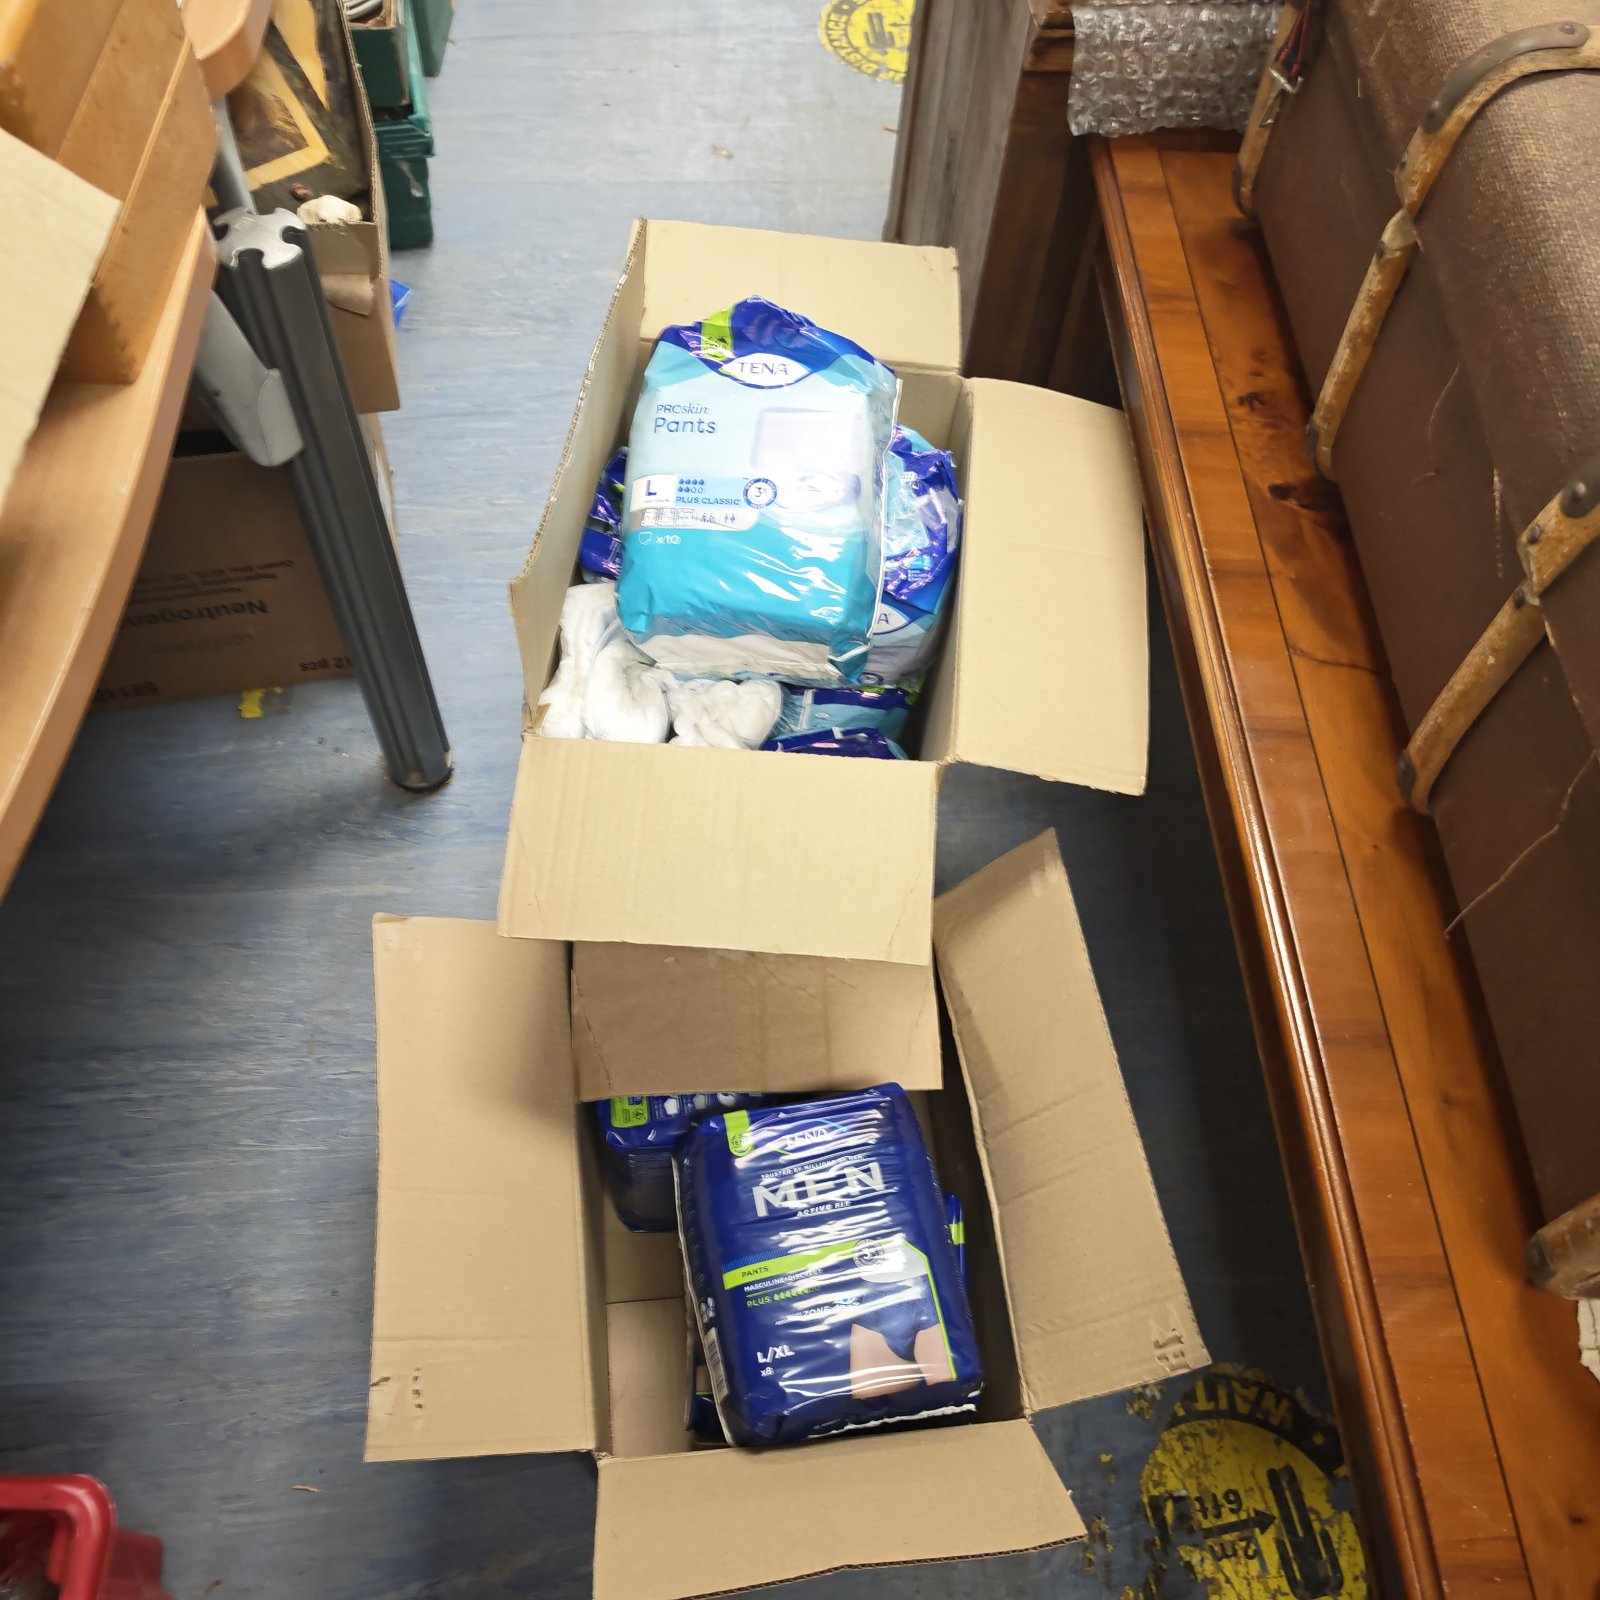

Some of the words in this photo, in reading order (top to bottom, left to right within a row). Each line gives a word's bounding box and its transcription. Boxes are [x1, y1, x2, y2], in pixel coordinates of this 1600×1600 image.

[739, 362, 790, 376] TENA
[653, 417, 717, 434] Pants
[645, 480, 657, 496] L
[676, 495, 699, 504] PLUS
[701, 497, 740, 506] CLASSIC
[656, 534, 681, 545] x10
[121, 600, 268, 630] Neutrogen
[298, 656, 328, 672] pcs
[752, 1162, 885, 1217] MEN
[797, 1202, 832, 1216] ACTIVE
[834, 1199, 851, 1209] FIT
[741, 1266, 769, 1277] PANTS
[746, 1296, 771, 1307] PLUS
[756, 1344, 795, 1363] L/XL
[760, 1367, 774, 1377] x8
[1193, 1379, 1293, 1431] WAIT
